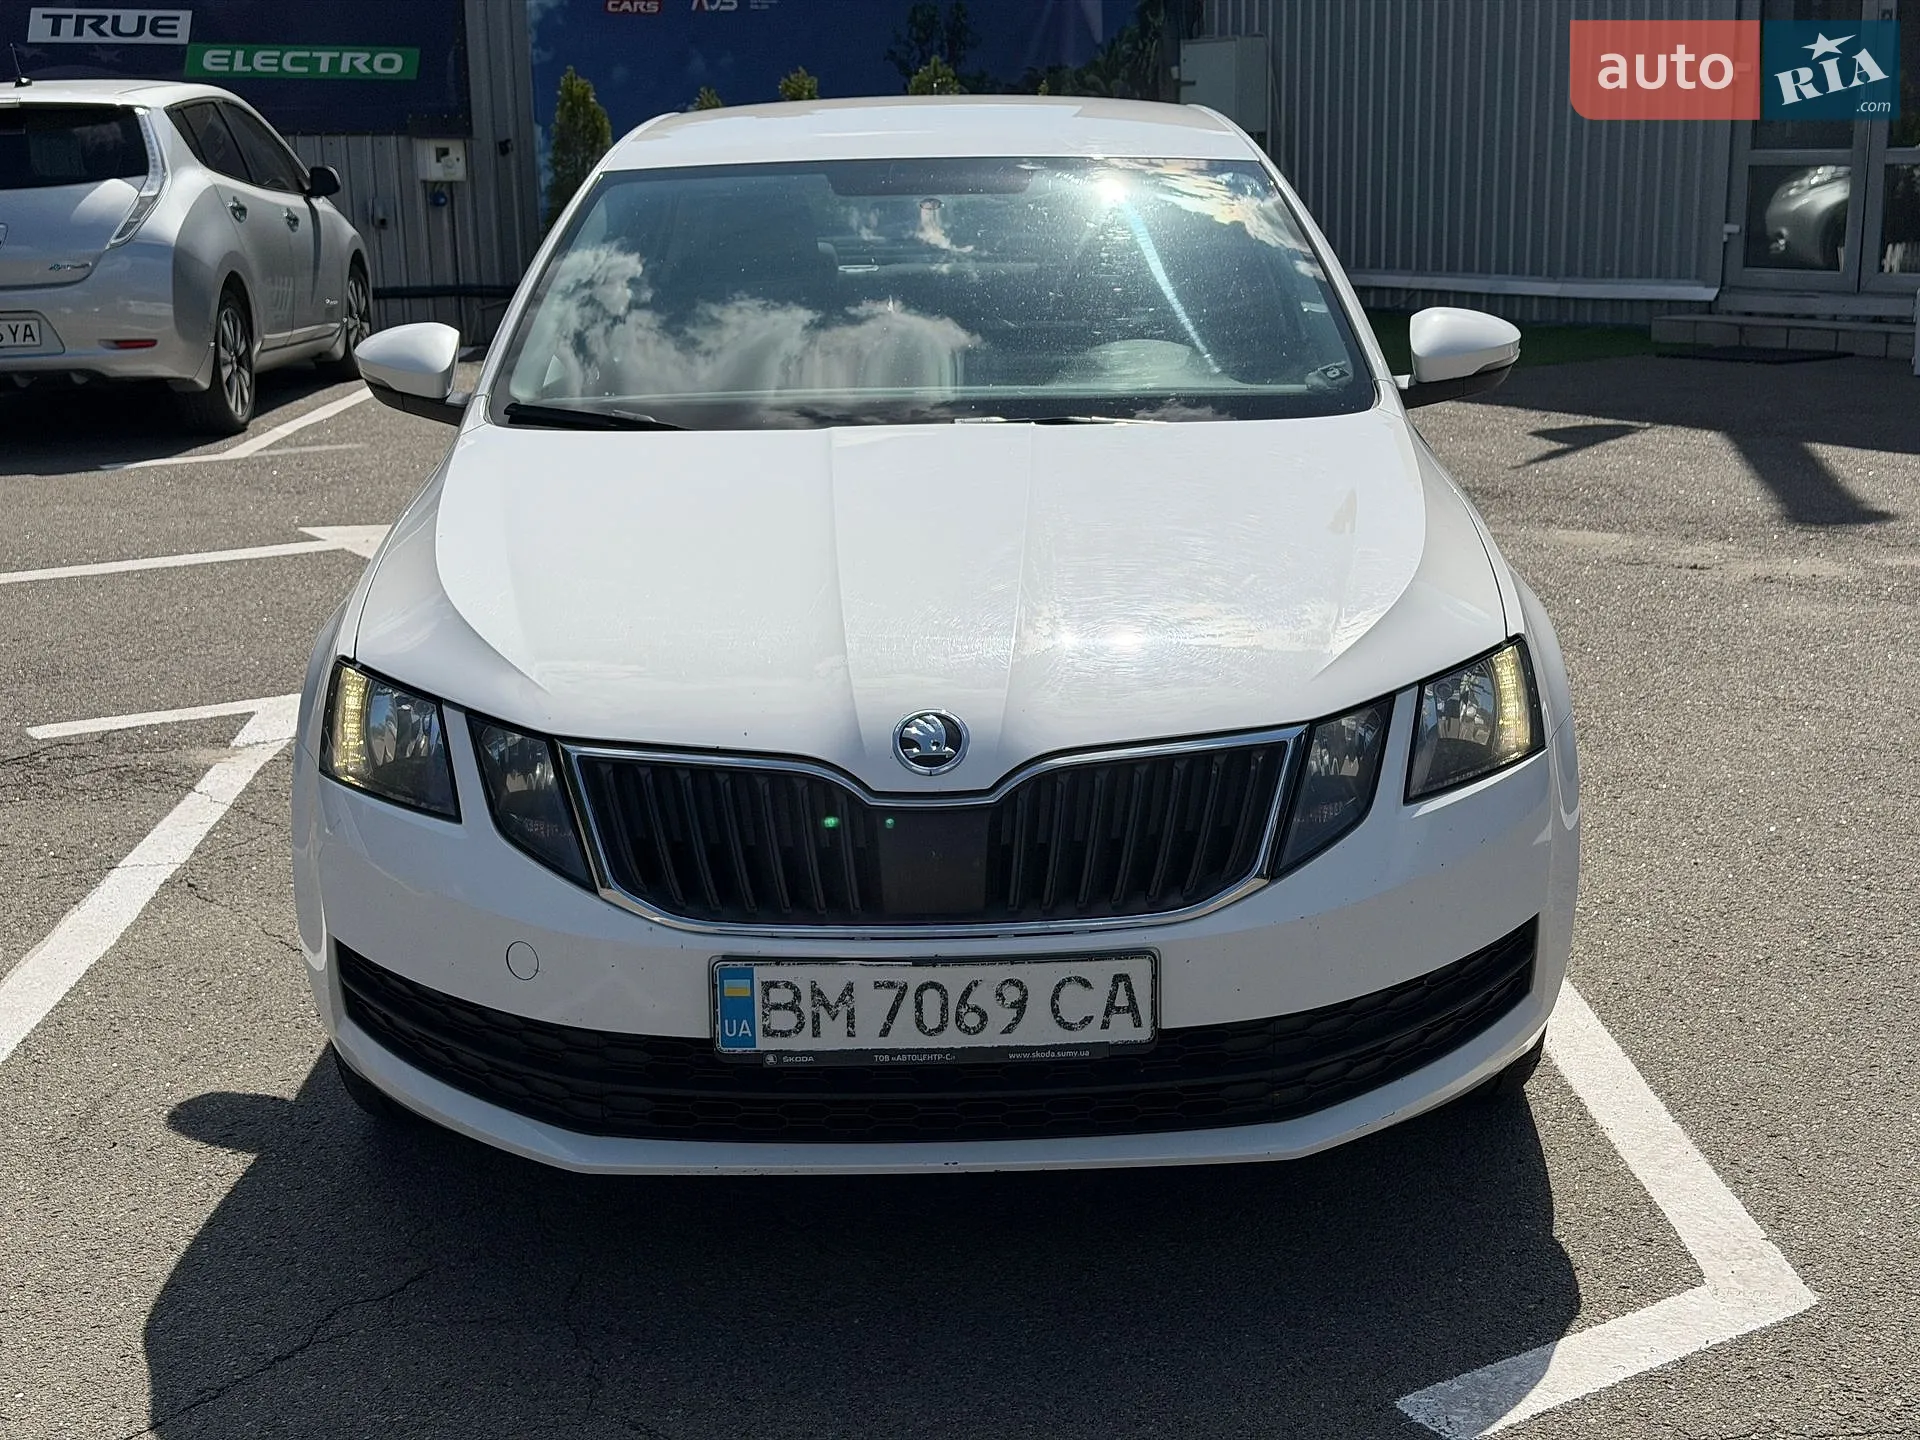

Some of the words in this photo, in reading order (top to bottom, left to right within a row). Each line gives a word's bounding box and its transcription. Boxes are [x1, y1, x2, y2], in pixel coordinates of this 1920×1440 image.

[607, 0, 659, 13] CARS
[41, 13, 181, 39] TRUE
[202, 49, 403, 75] ELECTRO
[761, 979, 856, 1039] BM
[873, 978, 1029, 1037] 7069
[1050, 973, 1143, 1032] CA
[725, 1020, 753, 1038] UA
[1008, 1050, 1090, 1060] www.skoda.sumy.ua
